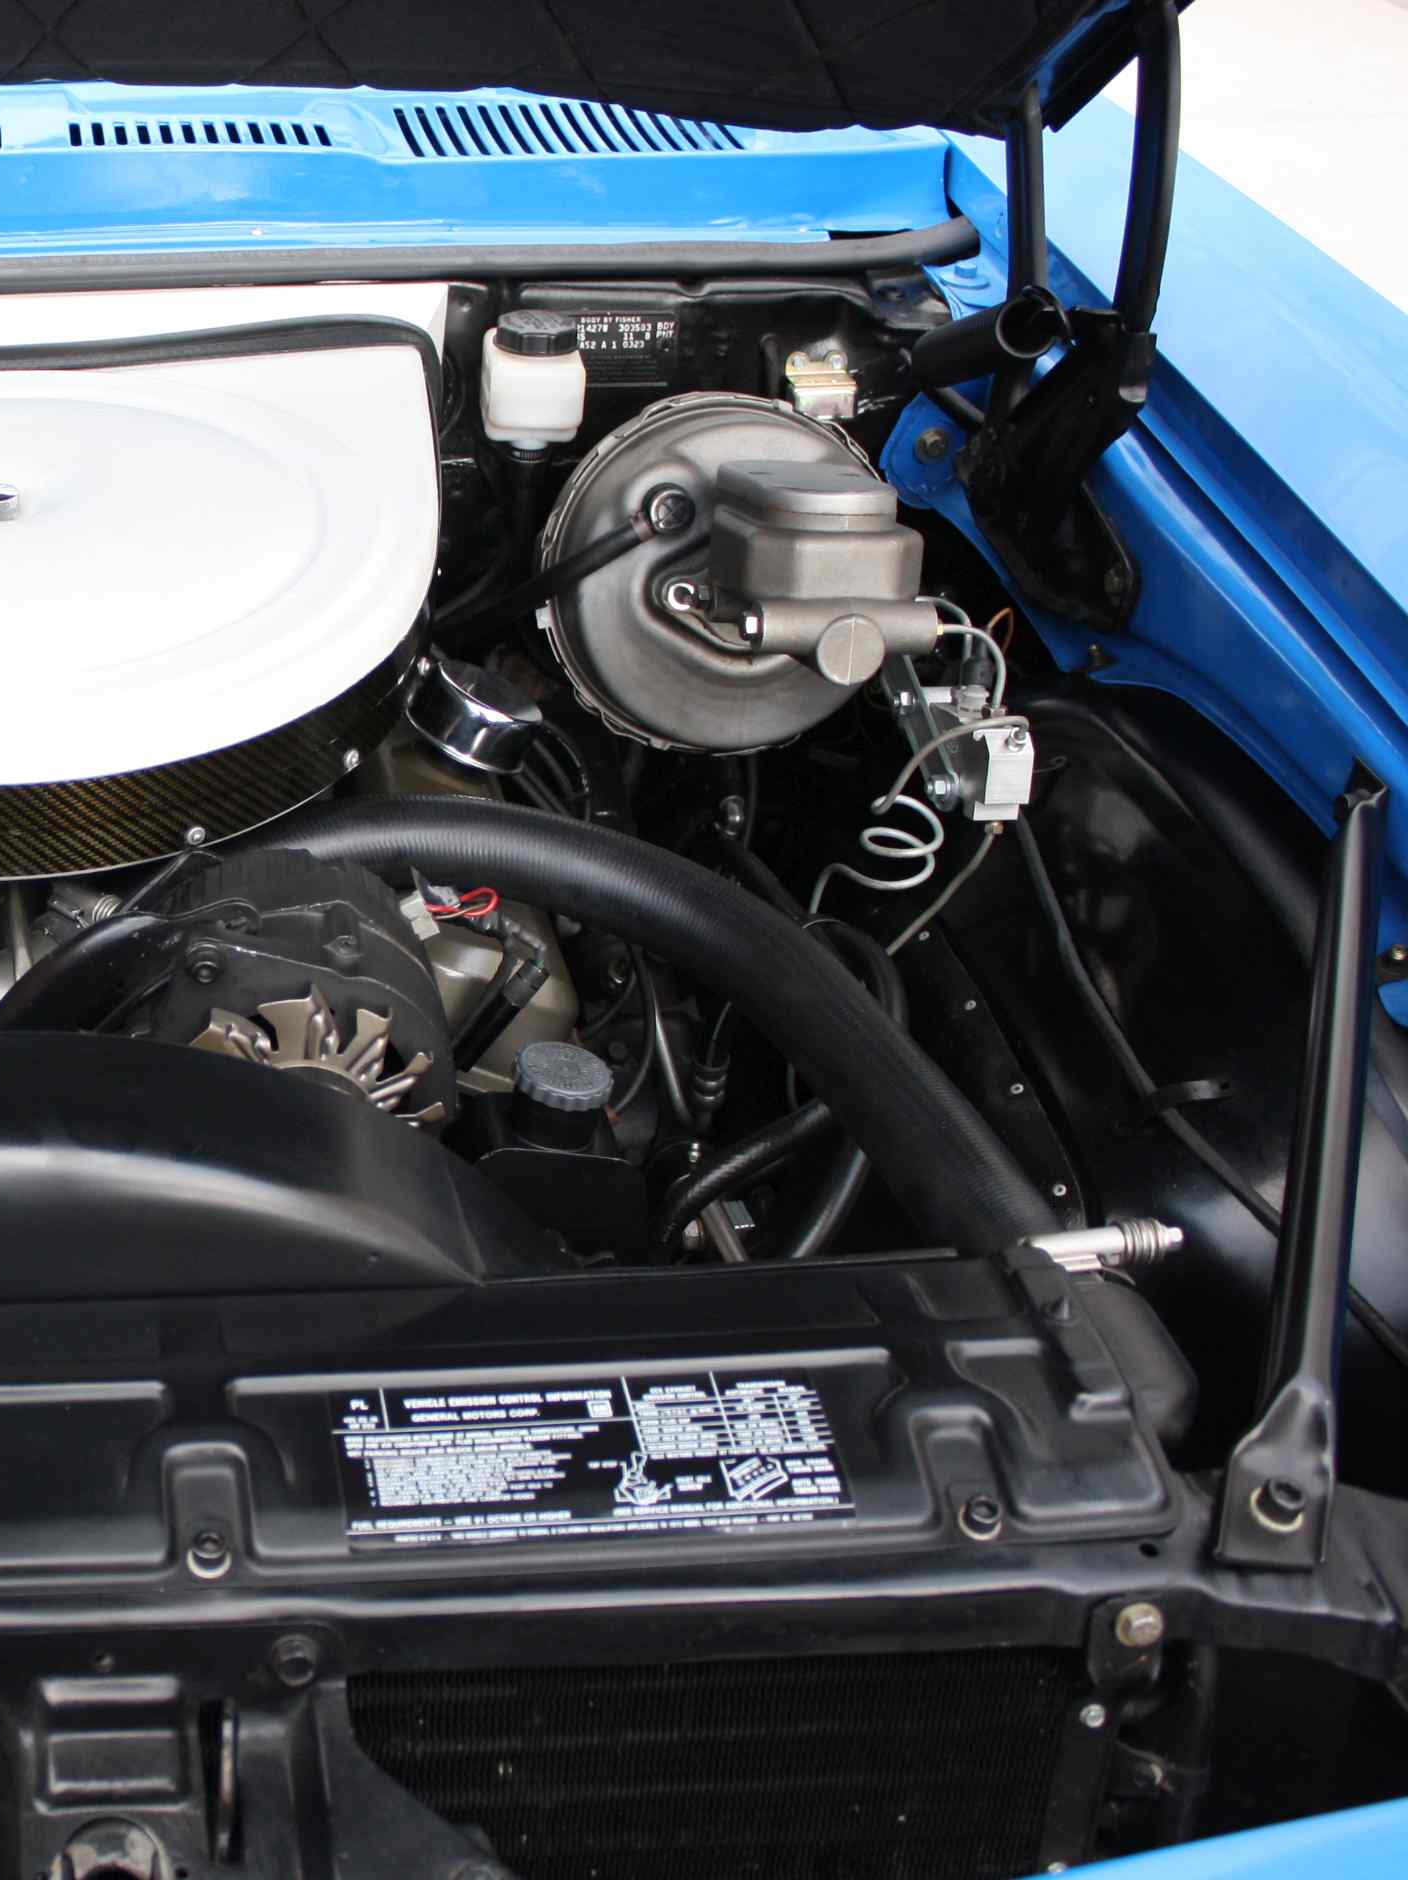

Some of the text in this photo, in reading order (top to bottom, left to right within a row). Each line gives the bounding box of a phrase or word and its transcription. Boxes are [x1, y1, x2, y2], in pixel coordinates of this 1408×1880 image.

[580, 315, 641, 324] BODY BY FISHER
[498, 1393, 543, 1405] CONTROL
[545, 1390, 612, 1402] INFORMATION
[411, 1411, 460, 1422] GENERAL
[462, 1409, 506, 1421] MOTORS
